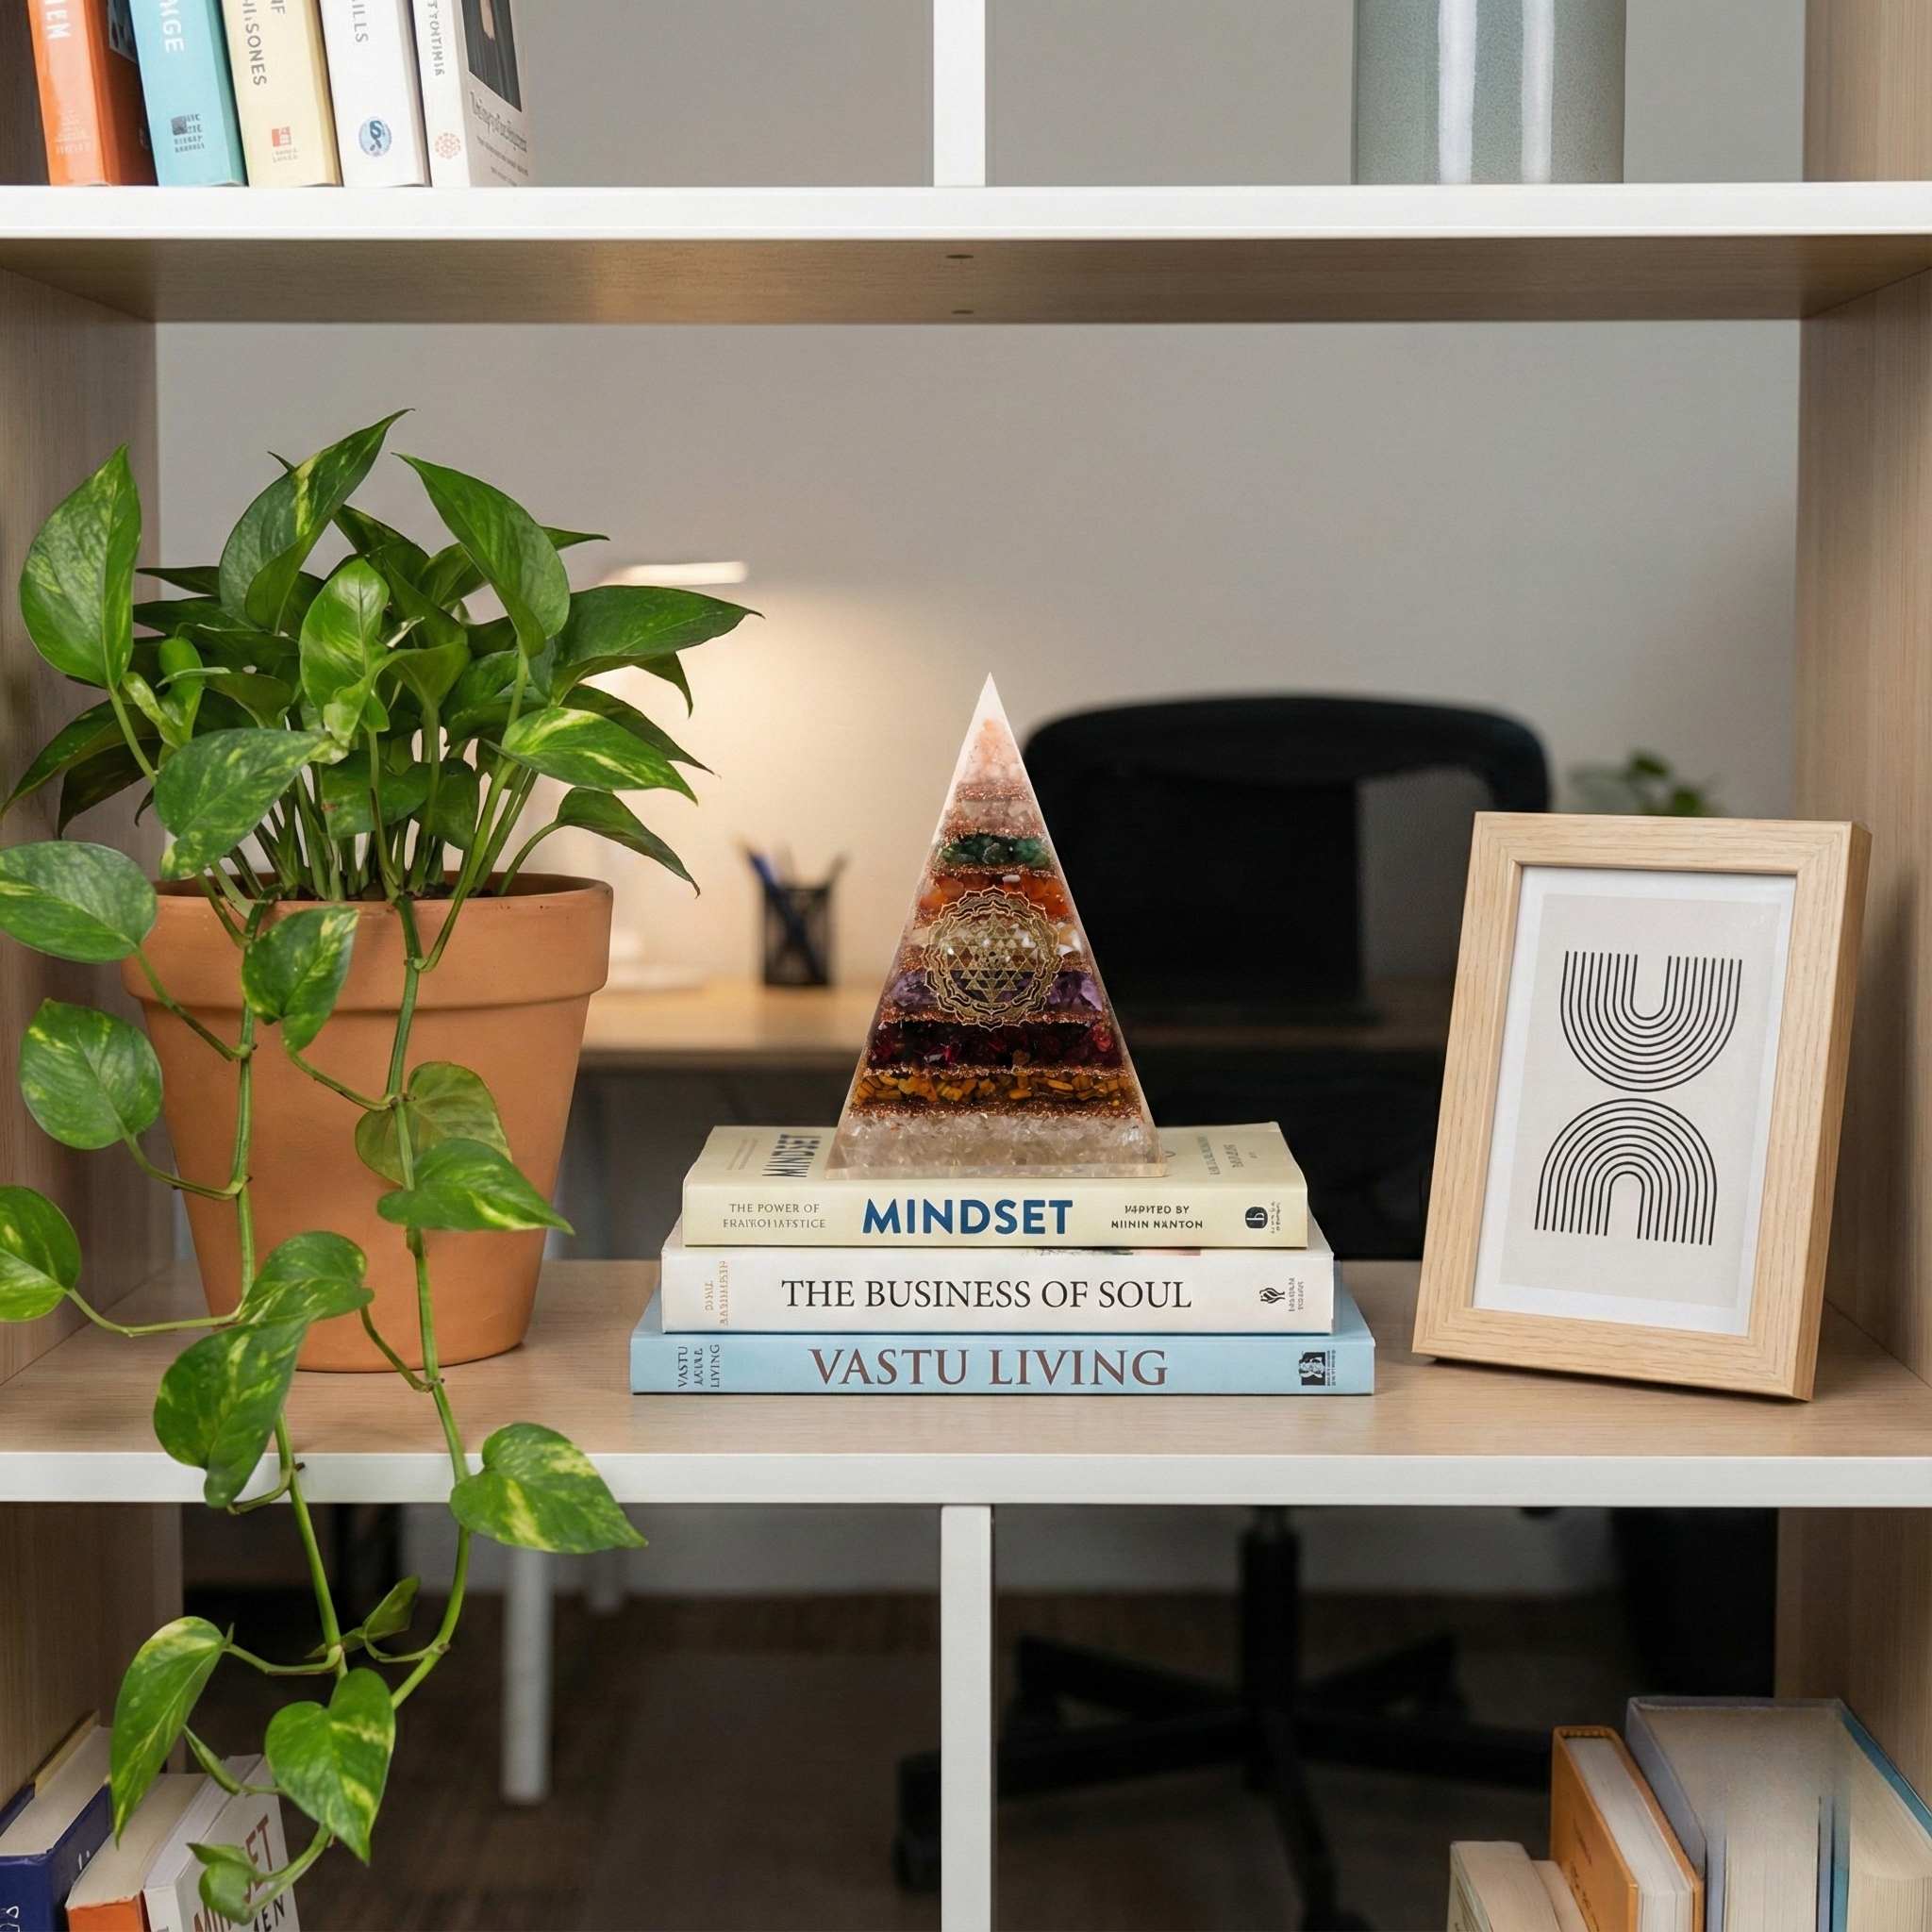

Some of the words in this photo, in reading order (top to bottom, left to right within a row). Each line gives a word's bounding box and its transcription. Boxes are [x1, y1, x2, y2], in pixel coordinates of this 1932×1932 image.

[728, 1203, 754, 1213] THE
[758, 1203, 800, 1213] POWER
[803, 1203, 820, 1213] OF
[863, 1199, 1074, 1234] MINDSET
[781, 1279, 856, 1307] THE
[864, 1280, 1031, 1308] BUSINESS
[1041, 1280, 1089, 1308] OF
[1098, 1280, 1192, 1308] SOUL
[677, 1346, 689, 1389] VASTU
[808, 1348, 970, 1385] VASTU
[989, 1349, 1169, 1386] LIVING
